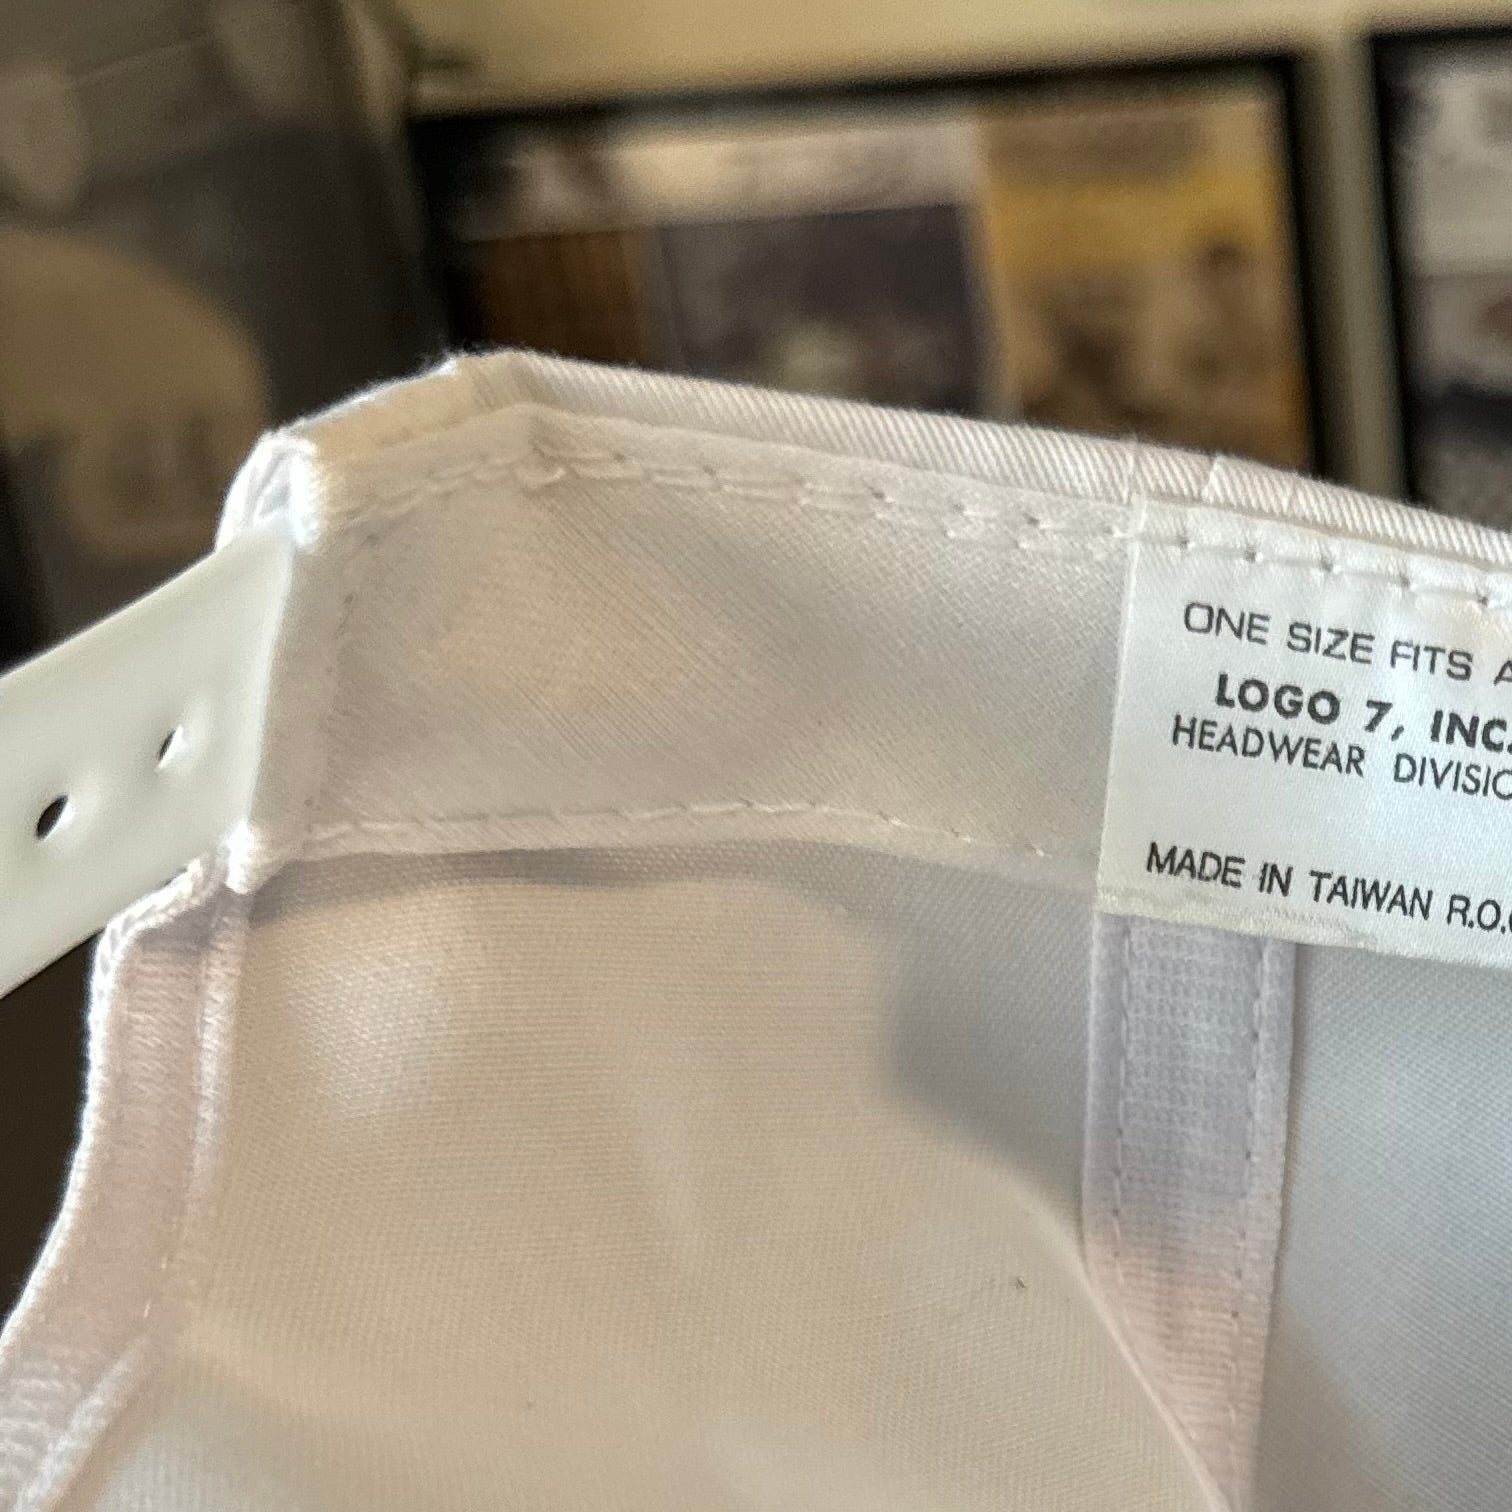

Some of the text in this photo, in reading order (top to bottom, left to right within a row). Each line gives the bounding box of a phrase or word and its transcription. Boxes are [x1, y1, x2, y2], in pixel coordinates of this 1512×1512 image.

[1183, 602, 1270, 645] ONE
[1286, 622, 1373, 664] SIZE
[1390, 640, 1472, 681] FITS
[1214, 673, 1341, 724] LOGO
[1364, 700, 1405, 742] 7,
[1171, 714, 1365, 777] HEADWEAR
[1146, 842, 1246, 888] MADE
[1258, 863, 1294, 896] IN
[1309, 870, 1433, 921] TAIWAN
